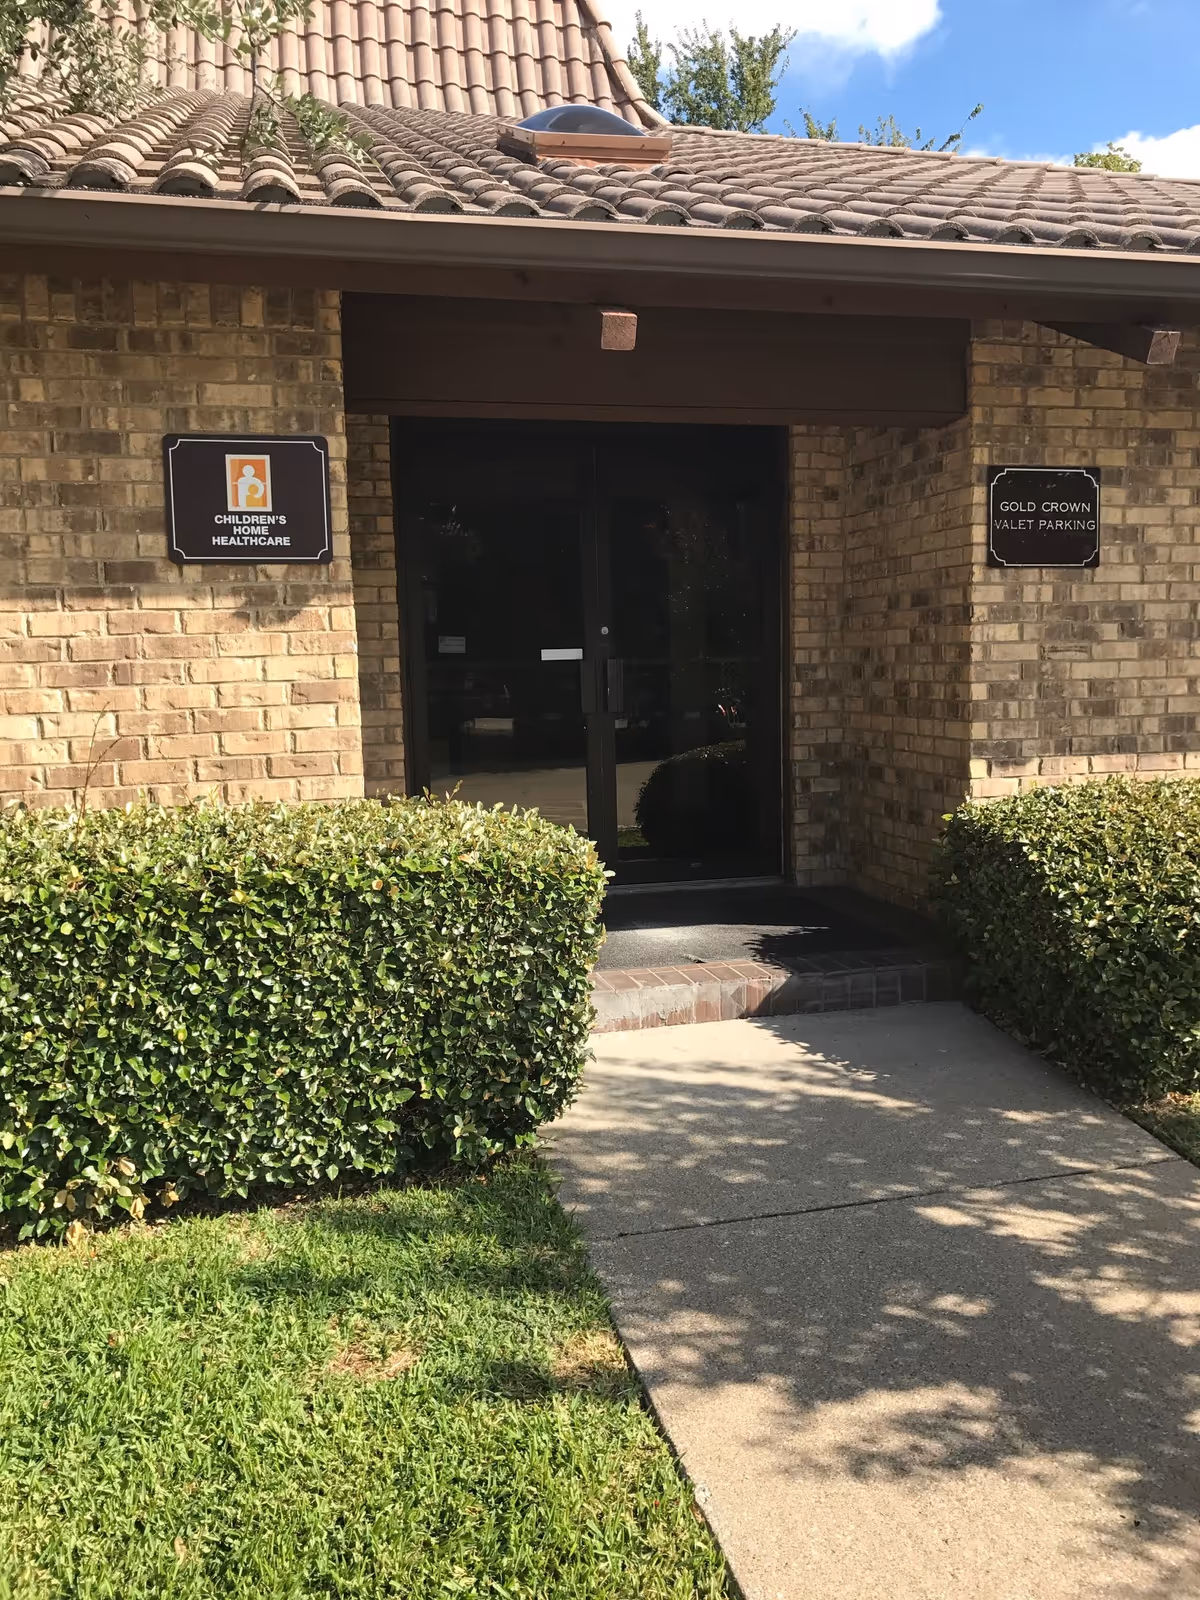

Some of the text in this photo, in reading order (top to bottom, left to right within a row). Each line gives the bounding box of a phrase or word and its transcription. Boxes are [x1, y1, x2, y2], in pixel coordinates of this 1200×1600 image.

[1000, 501, 1091, 512] GOLD CROWN
[214, 514, 287, 525] CHILDREN'S
[994, 519, 1096, 530] VALET PARKING
[233, 525, 269, 535] HOME
[212, 536, 291, 546] HEALTHCARE
